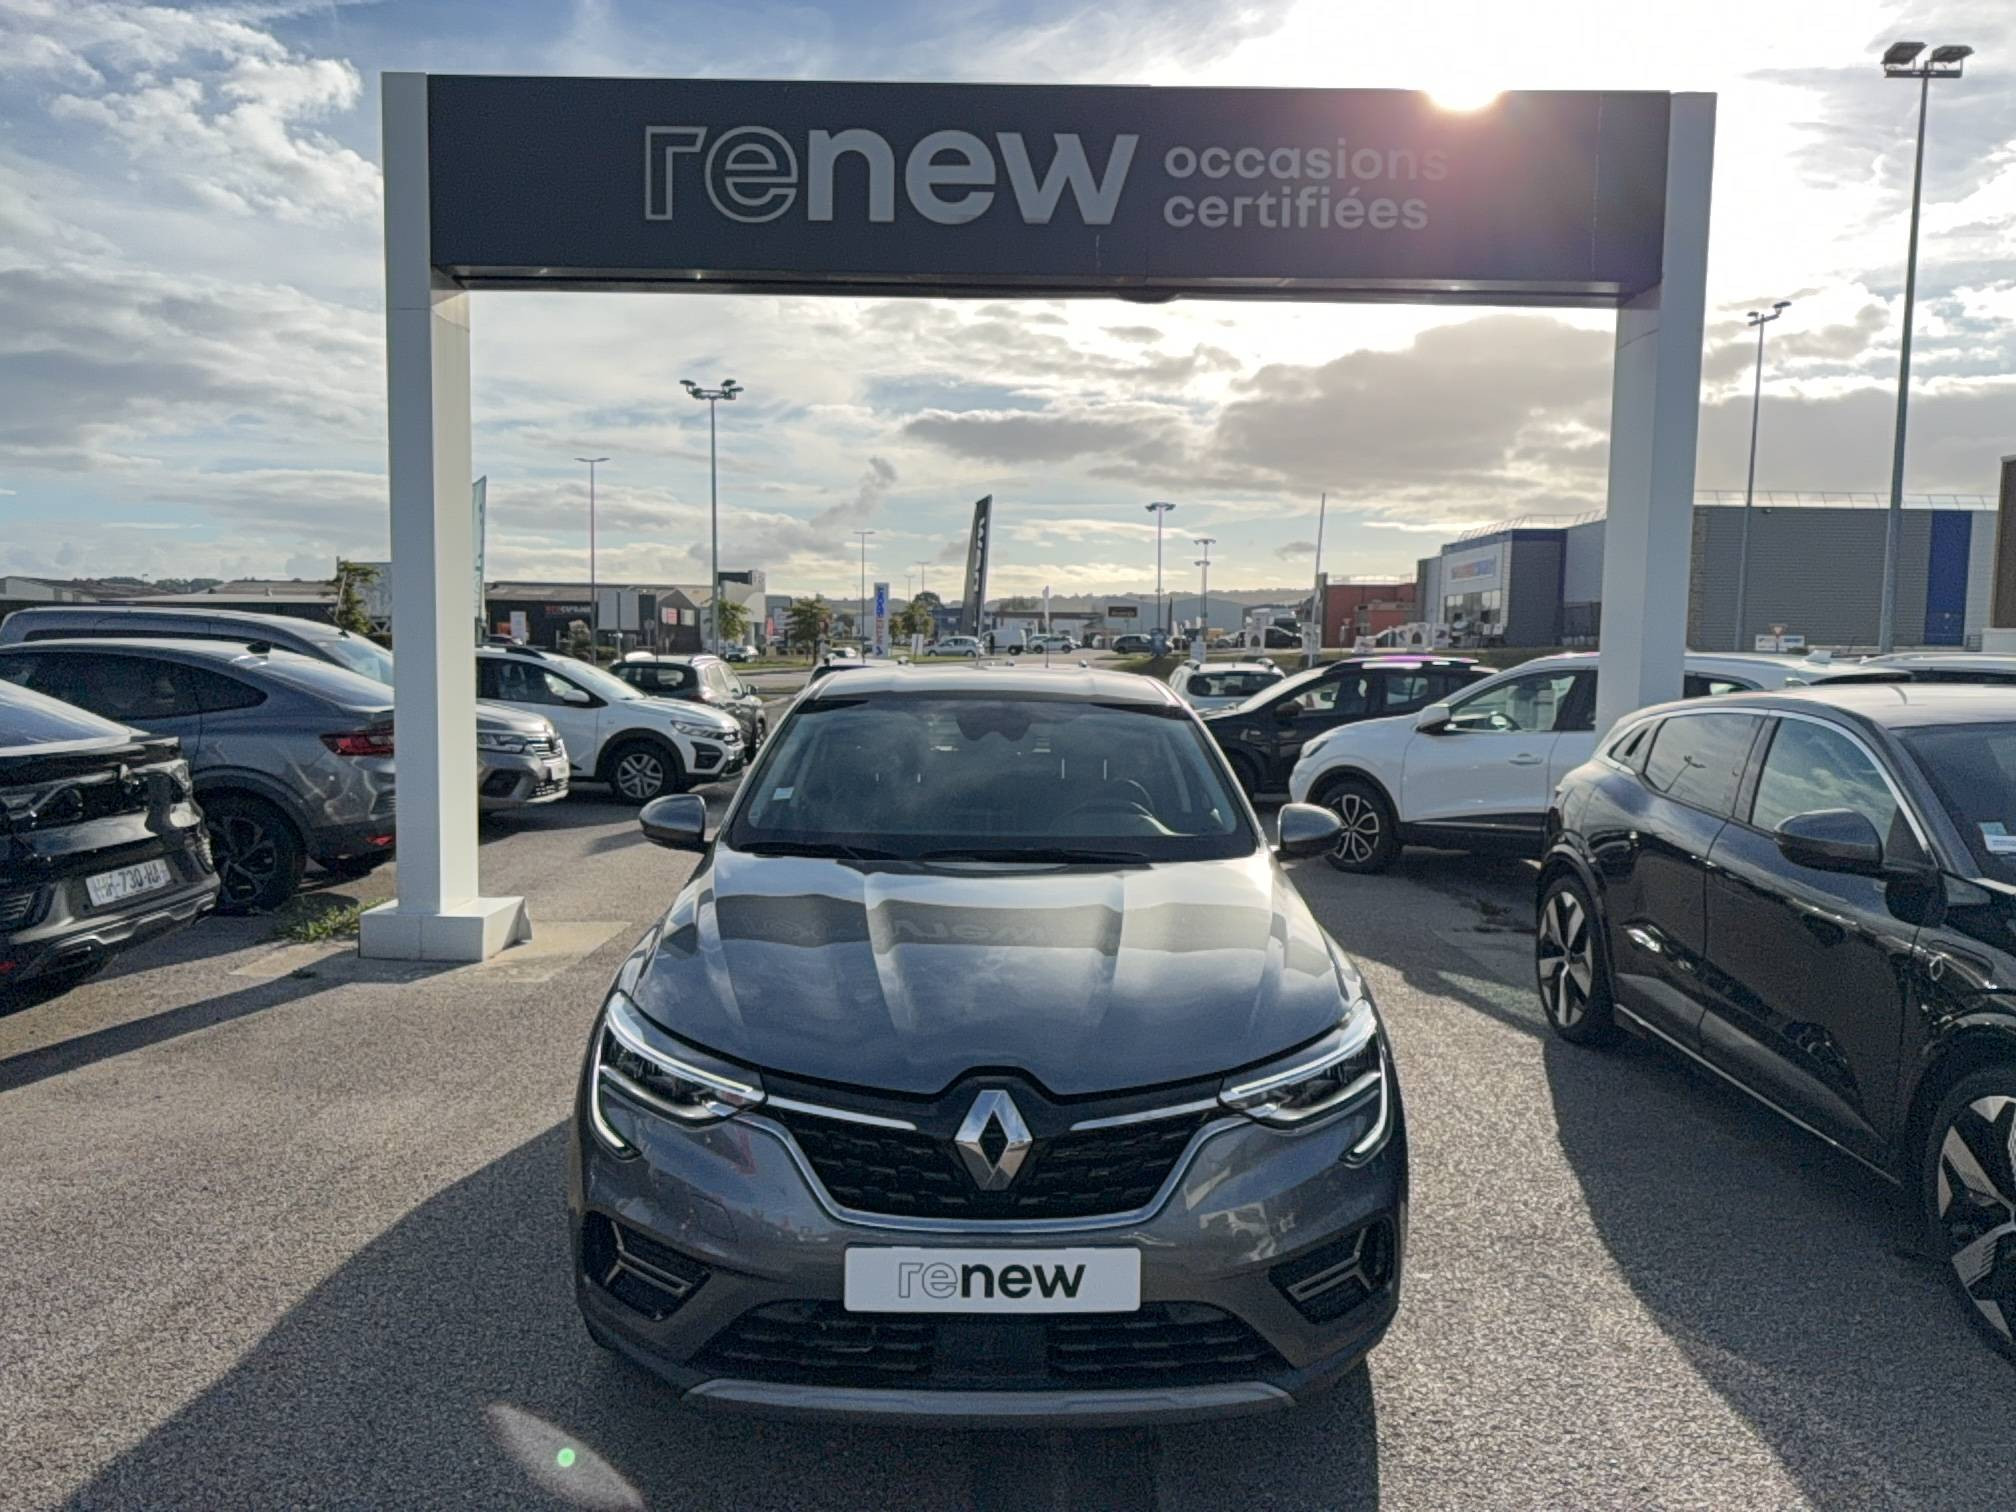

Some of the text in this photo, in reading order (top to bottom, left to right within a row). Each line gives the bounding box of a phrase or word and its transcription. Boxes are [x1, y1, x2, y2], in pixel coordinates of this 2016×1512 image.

[645, 125, 1139, 225] renew
[1164, 137, 1449, 181] occasions
[1163, 185, 1429, 230] certifiées
[899, 1262, 1086, 1299] renew
